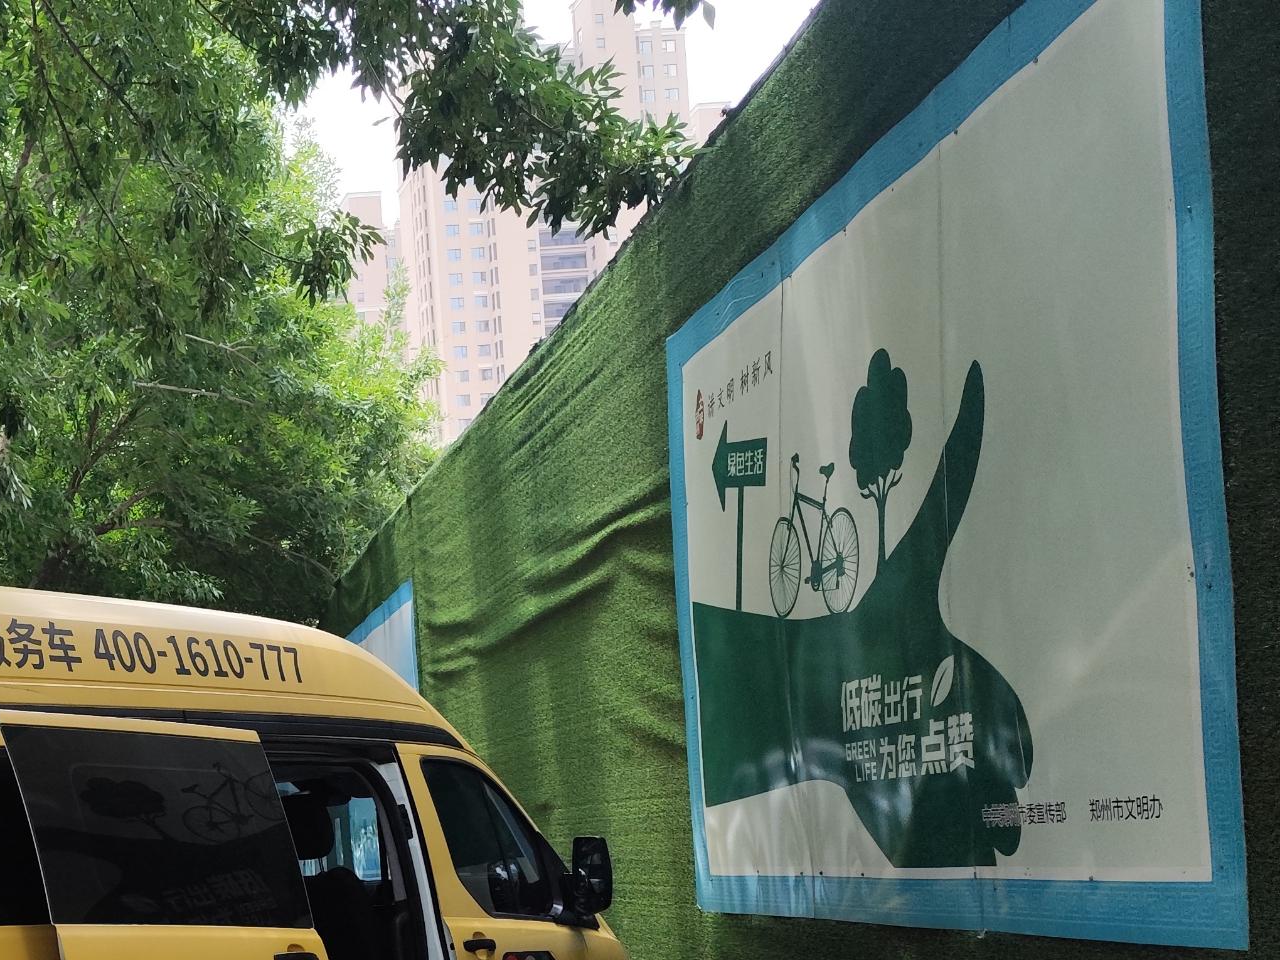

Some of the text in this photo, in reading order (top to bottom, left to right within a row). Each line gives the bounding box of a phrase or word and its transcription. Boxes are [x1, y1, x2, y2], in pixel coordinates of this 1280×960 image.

[740, 350, 773, 396] 树新风
[727, 448, 764, 477] 绿色生活
[94, 628, 303, 684] 400-1610-777
[840, 674, 923, 732] 低碳出行
[845, 738, 877, 762] GREEN
[854, 761, 878, 783] LIFE
[1089, 793, 1164, 822] 郑州市文明办
